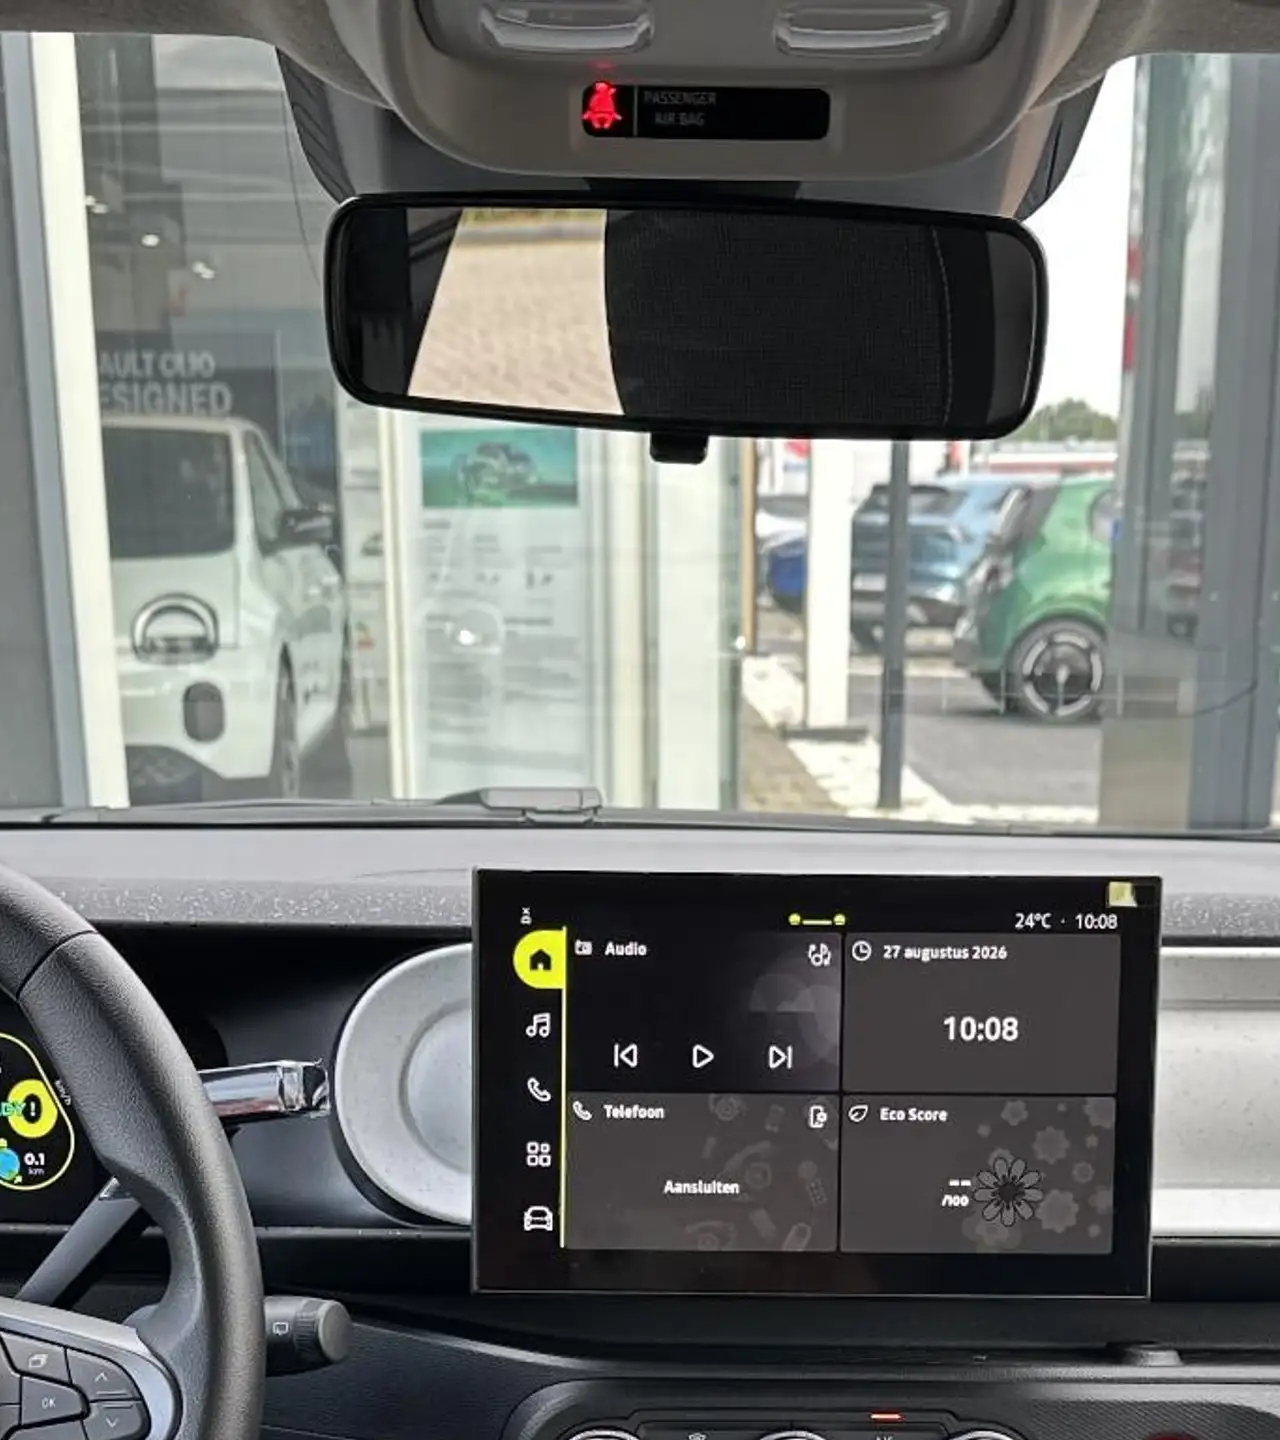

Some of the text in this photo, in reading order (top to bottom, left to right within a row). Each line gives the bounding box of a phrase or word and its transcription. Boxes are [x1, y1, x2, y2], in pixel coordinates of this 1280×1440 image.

[644, 91, 717, 106] PASSENGER
[654, 112, 705, 126] AIR BAG
[1014, 912, 1119, 930] 24°C 10:08
[604, 941, 647, 956] Audio
[883, 945, 1008, 963] 27 augustus 2026
[943, 1016, 1019, 1042] 10:08
[604, 1104, 665, 1120] Telefoon
[880, 1107, 948, 1122] Eco Score
[23, 1152, 45, 1166] 0.1
[664, 1179, 740, 1195] Aansluiten
[941, 1193, 970, 1208] /100
[41, 1397, 57, 1409] OK
